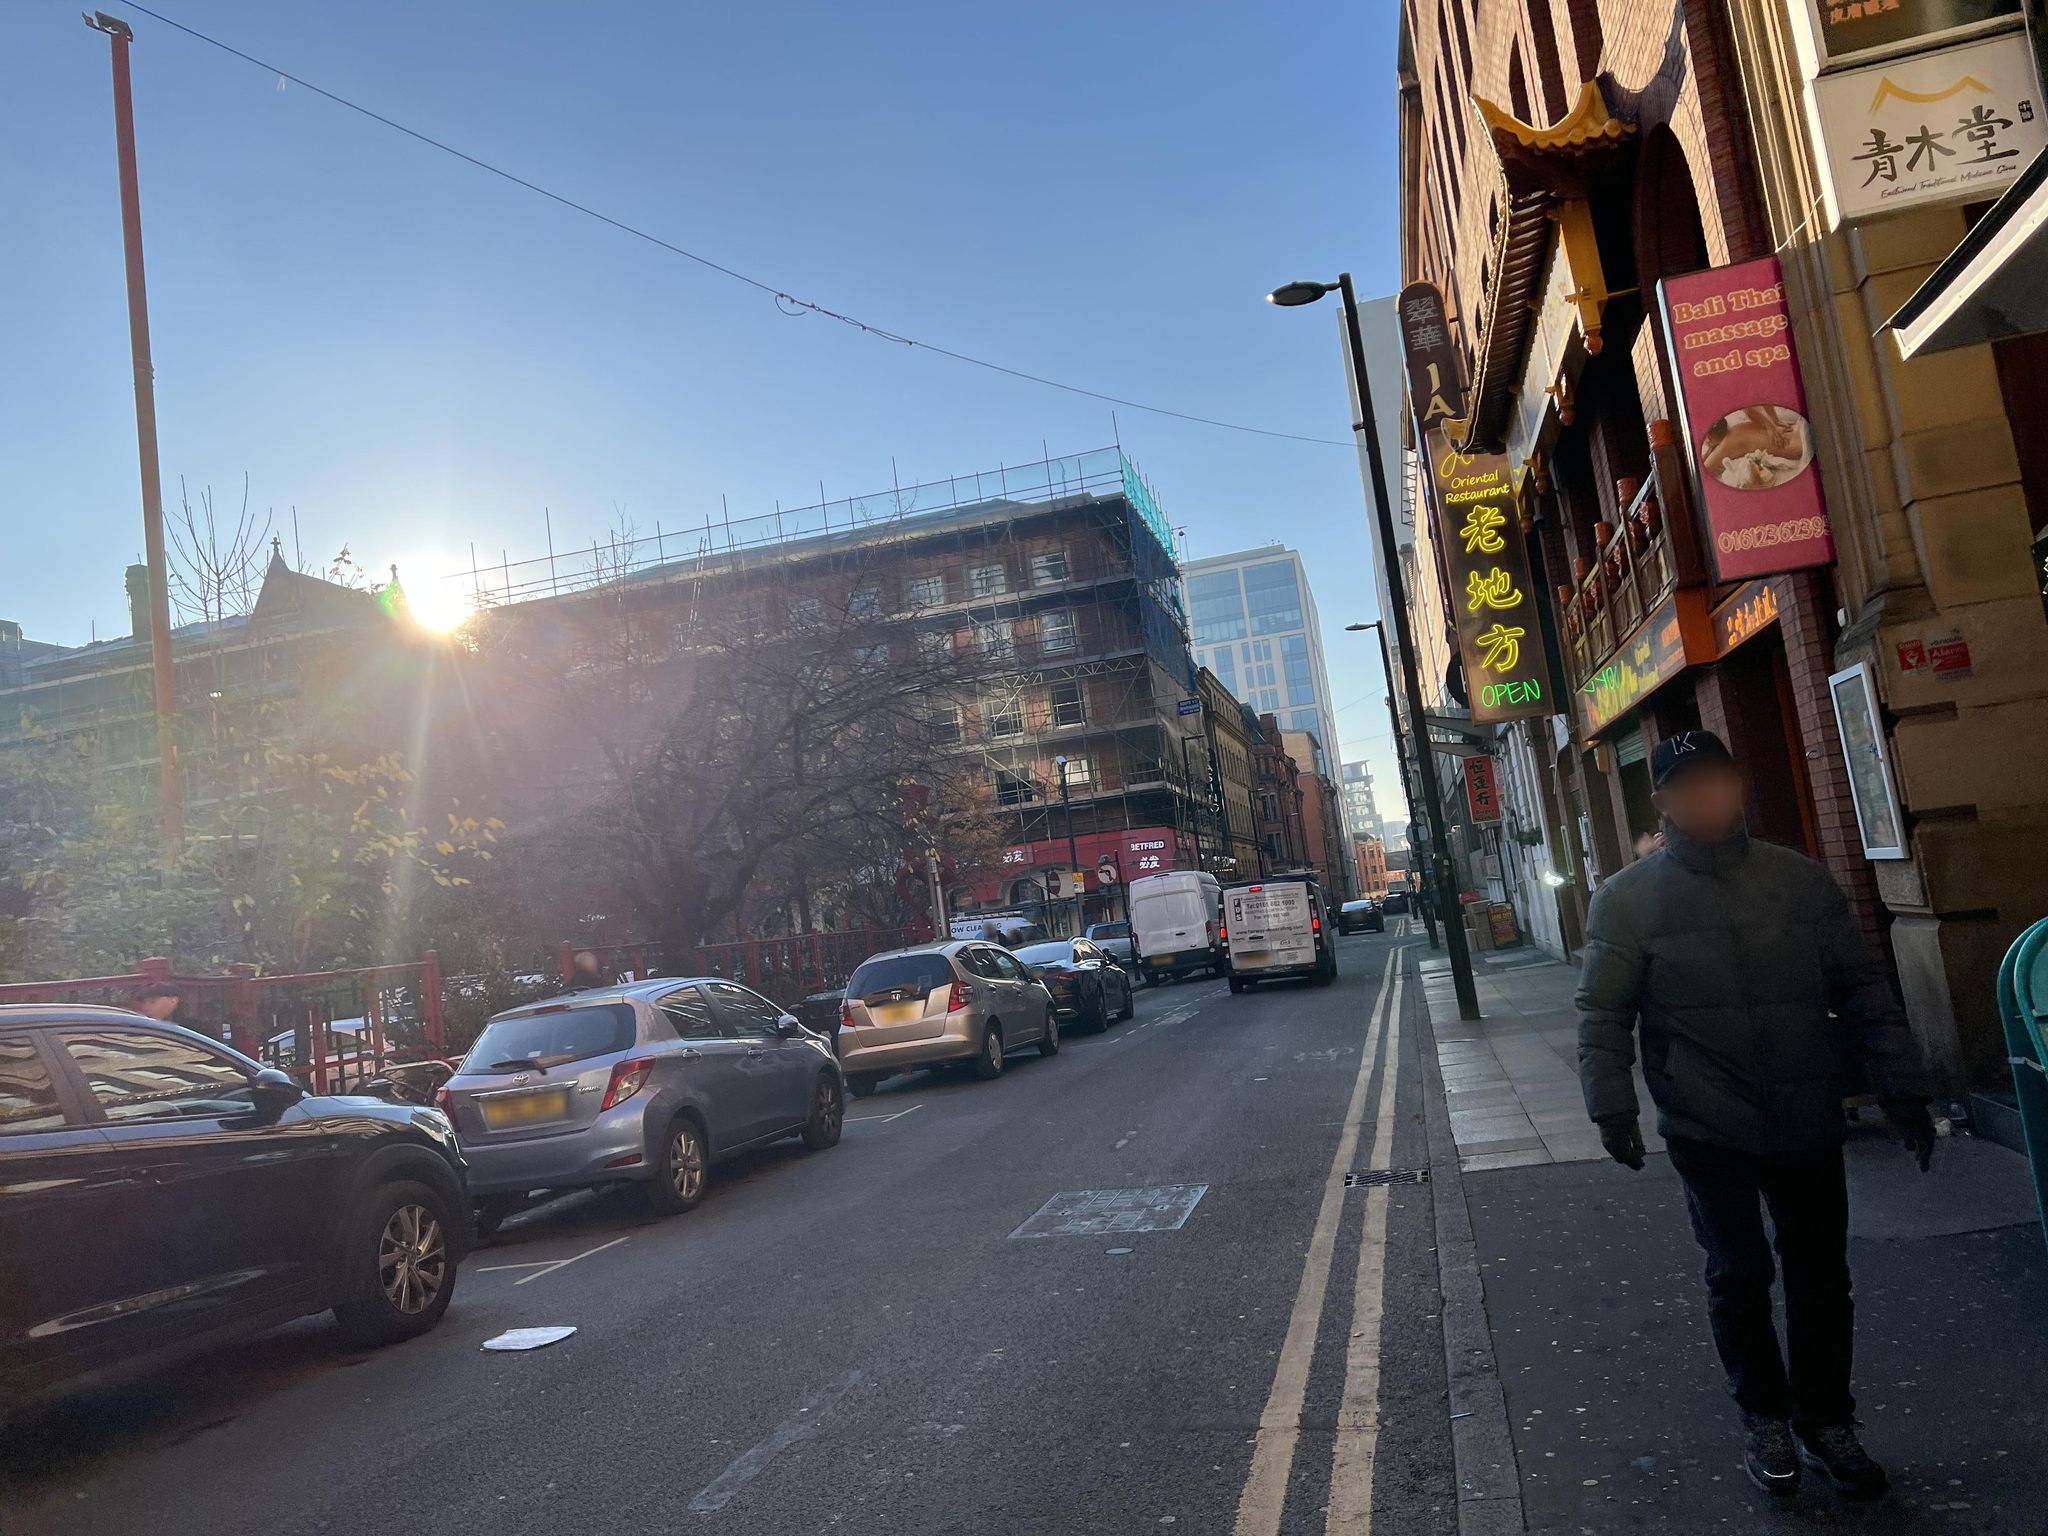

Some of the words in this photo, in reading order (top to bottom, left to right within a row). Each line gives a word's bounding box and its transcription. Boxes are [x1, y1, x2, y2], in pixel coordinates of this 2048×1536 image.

[1851, 104, 2020, 189] 青木堂
[1673, 295, 1725, 324] Bali
[1727, 282, 1786, 311] Thai
[1684, 314, 1788, 350] massage
[1694, 350, 1742, 377] and
[1746, 344, 1790, 368] spa
[1445, 483, 1510, 504] Restaurant
[1451, 469, 1499, 489] Oriental
[1460, 505, 1524, 673] 老地方
[1480, 677, 1542, 709] OPEN
[1671, 731, 1696, 755] K
[1130, 840, 1165, 851] BETFRED
[966, 922, 1002, 932] CLEAG
